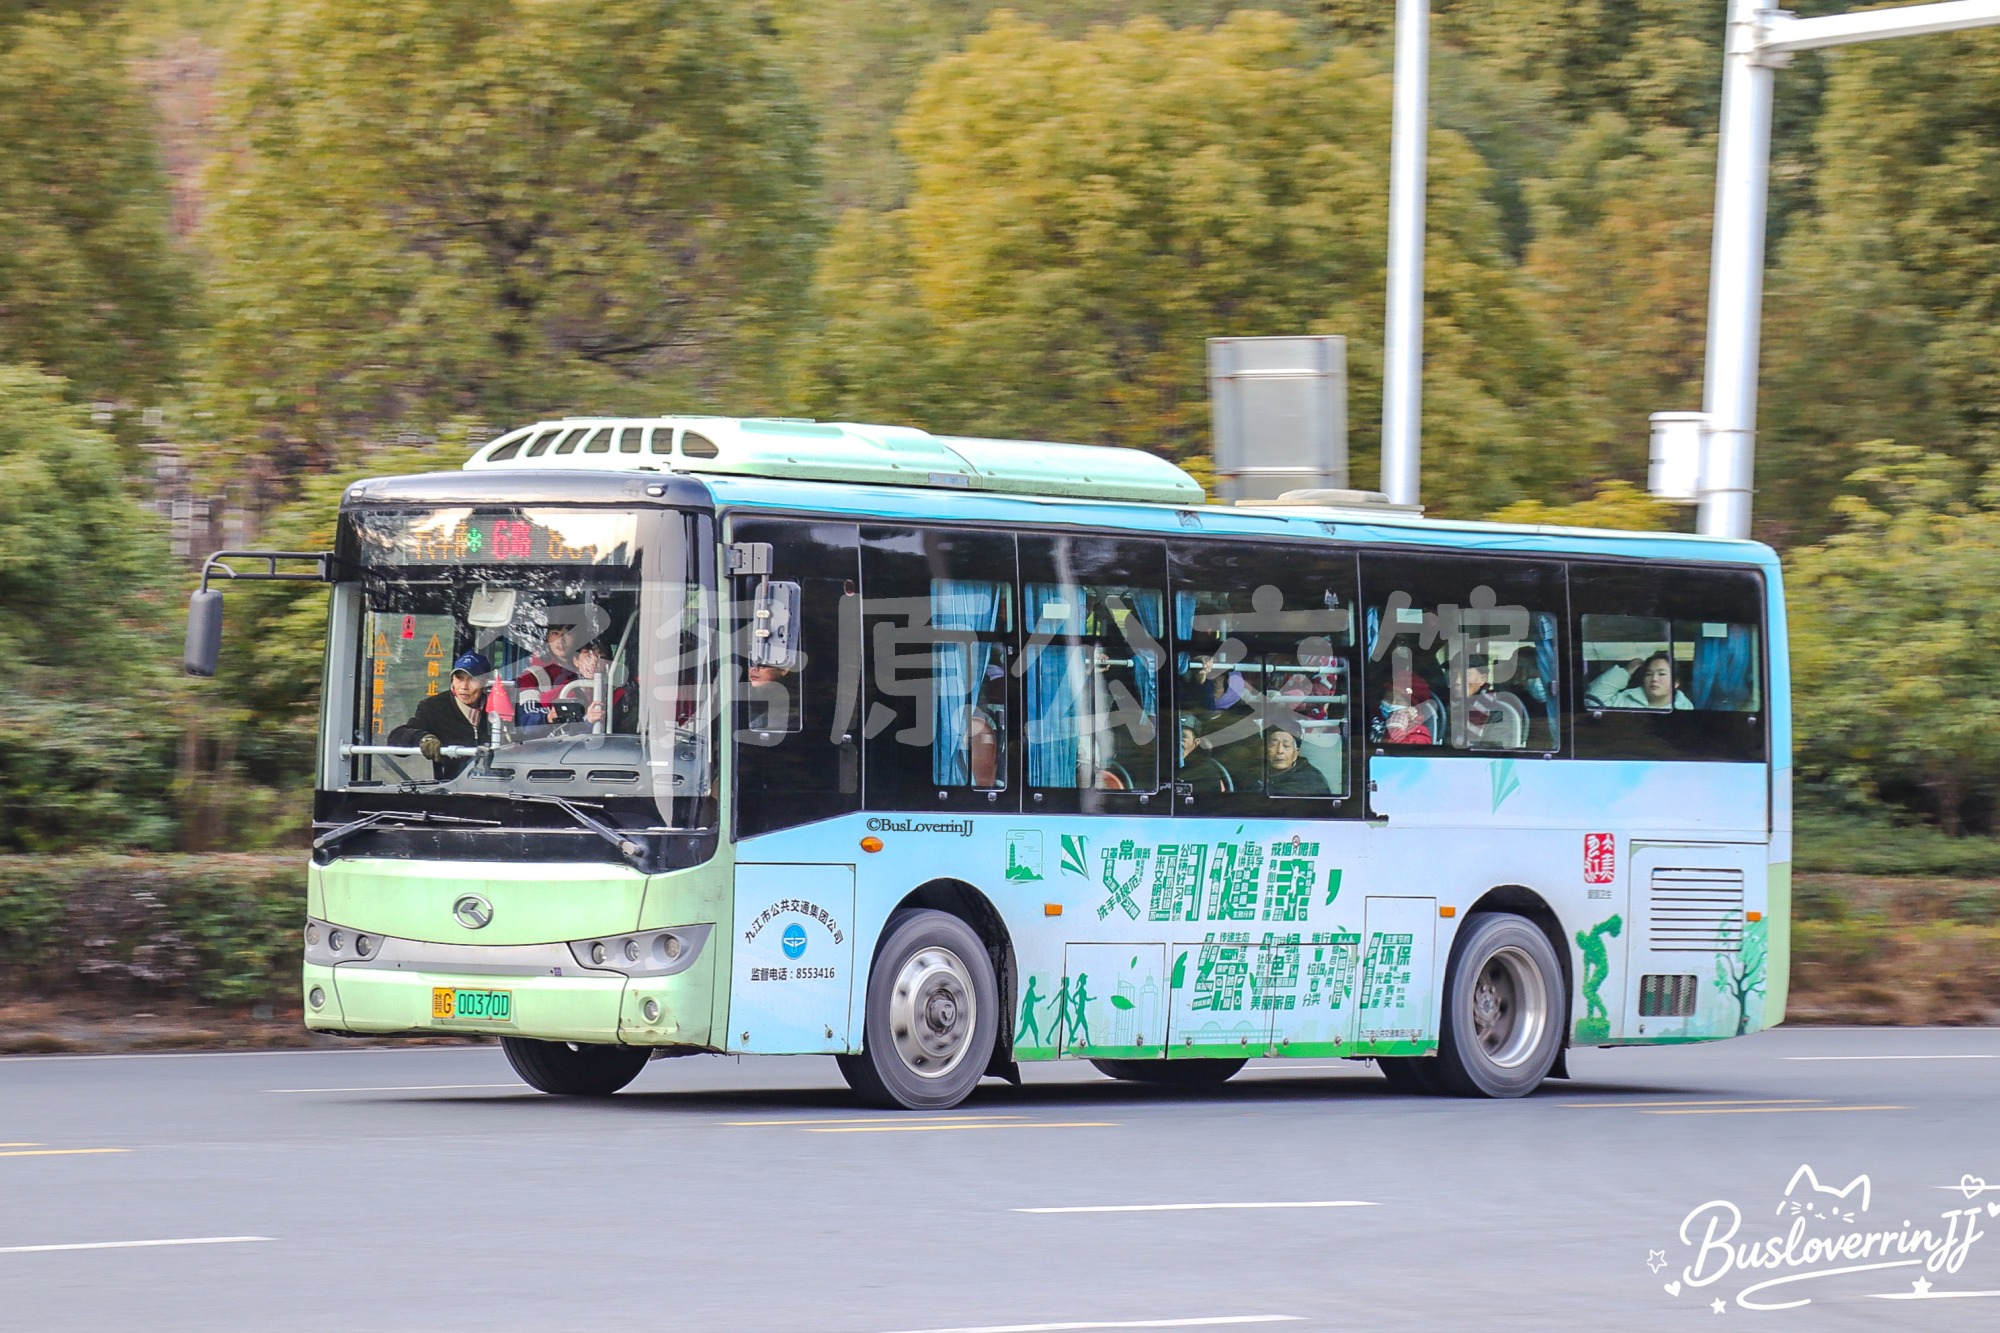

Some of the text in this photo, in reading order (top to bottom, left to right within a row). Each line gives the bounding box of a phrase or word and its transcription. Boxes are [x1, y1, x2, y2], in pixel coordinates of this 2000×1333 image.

[744, 898, 845, 946] 九江市公共交通集团公司
